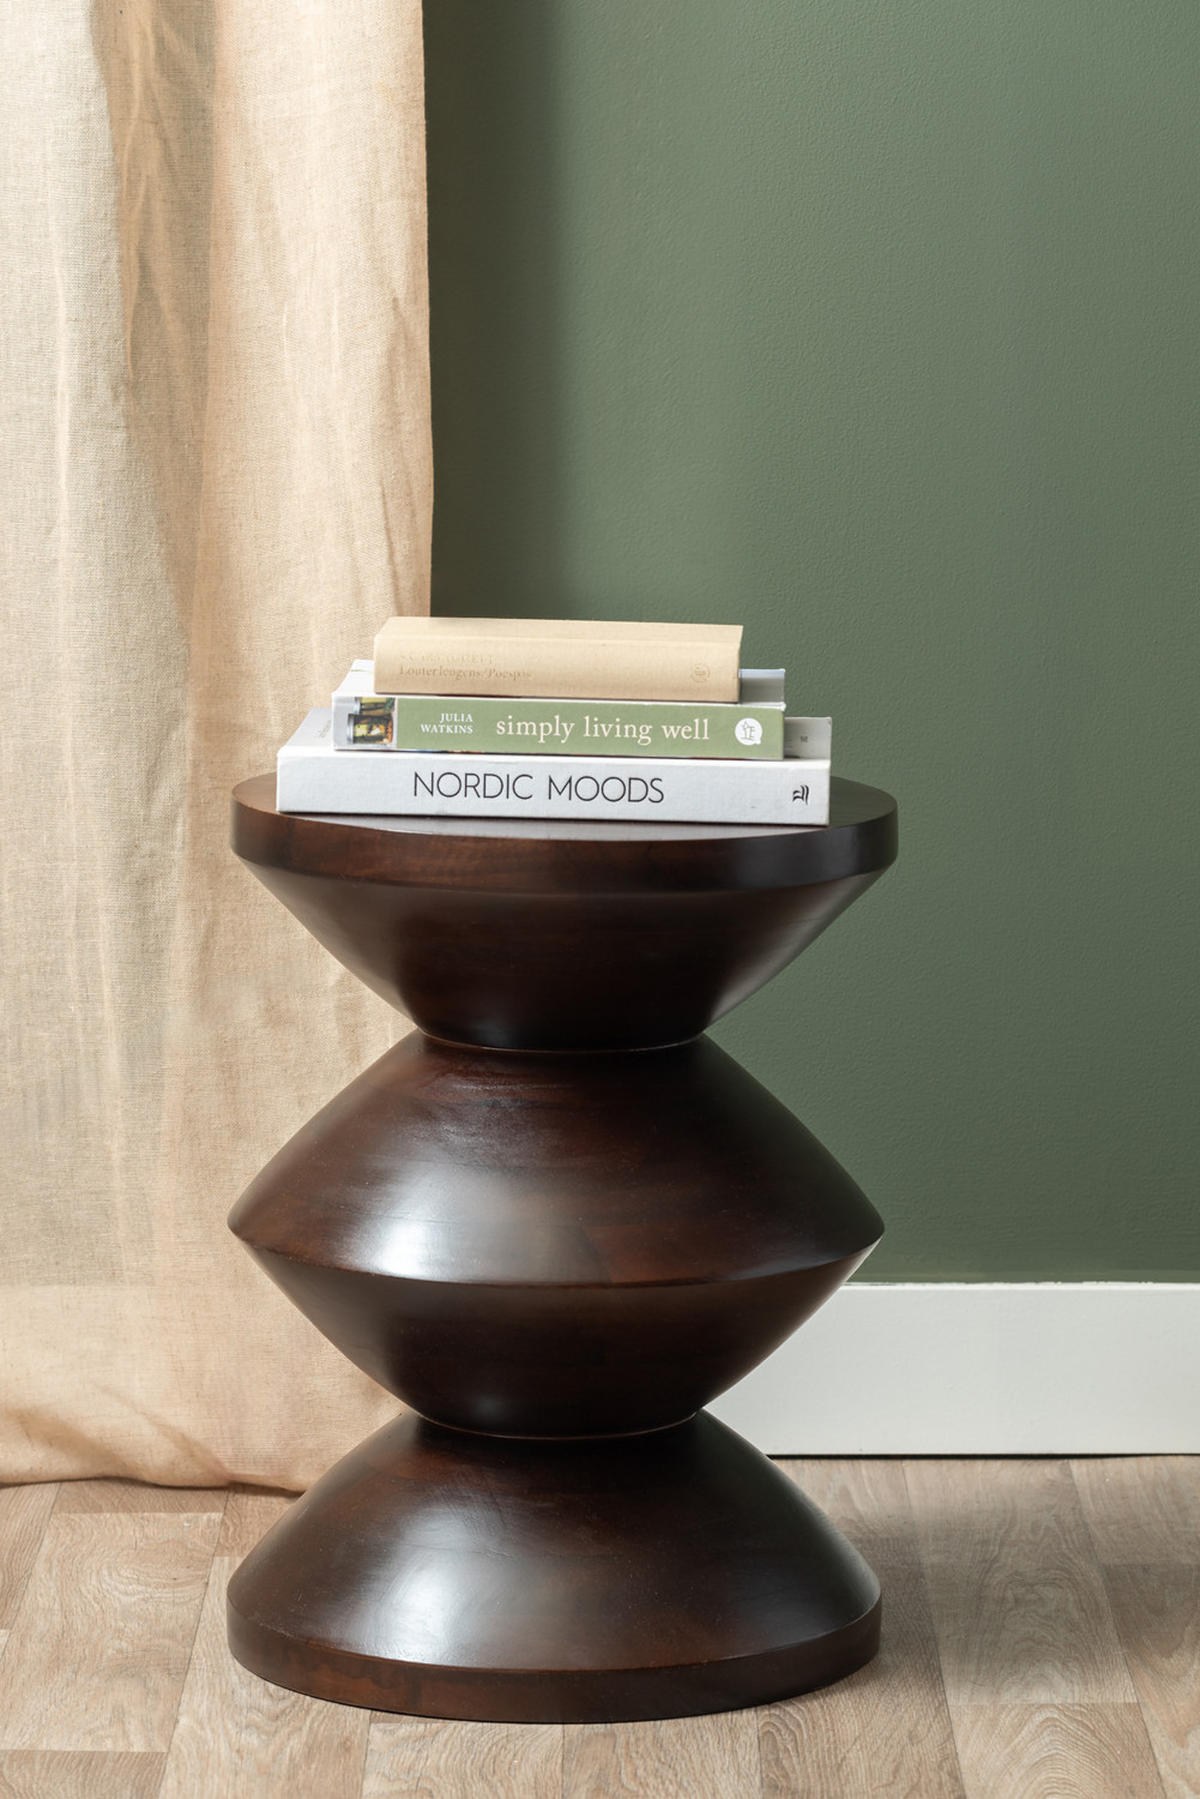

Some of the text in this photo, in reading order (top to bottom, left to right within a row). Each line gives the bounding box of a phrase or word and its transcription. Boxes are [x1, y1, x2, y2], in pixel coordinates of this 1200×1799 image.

[438, 712, 474, 723] JULIA
[420, 723, 474, 735] WATKINS
[495, 714, 576, 744] simply
[583, 715, 653, 746] living
[660, 718, 711, 740] well
[413, 771, 665, 804] NORDIC MOODS
